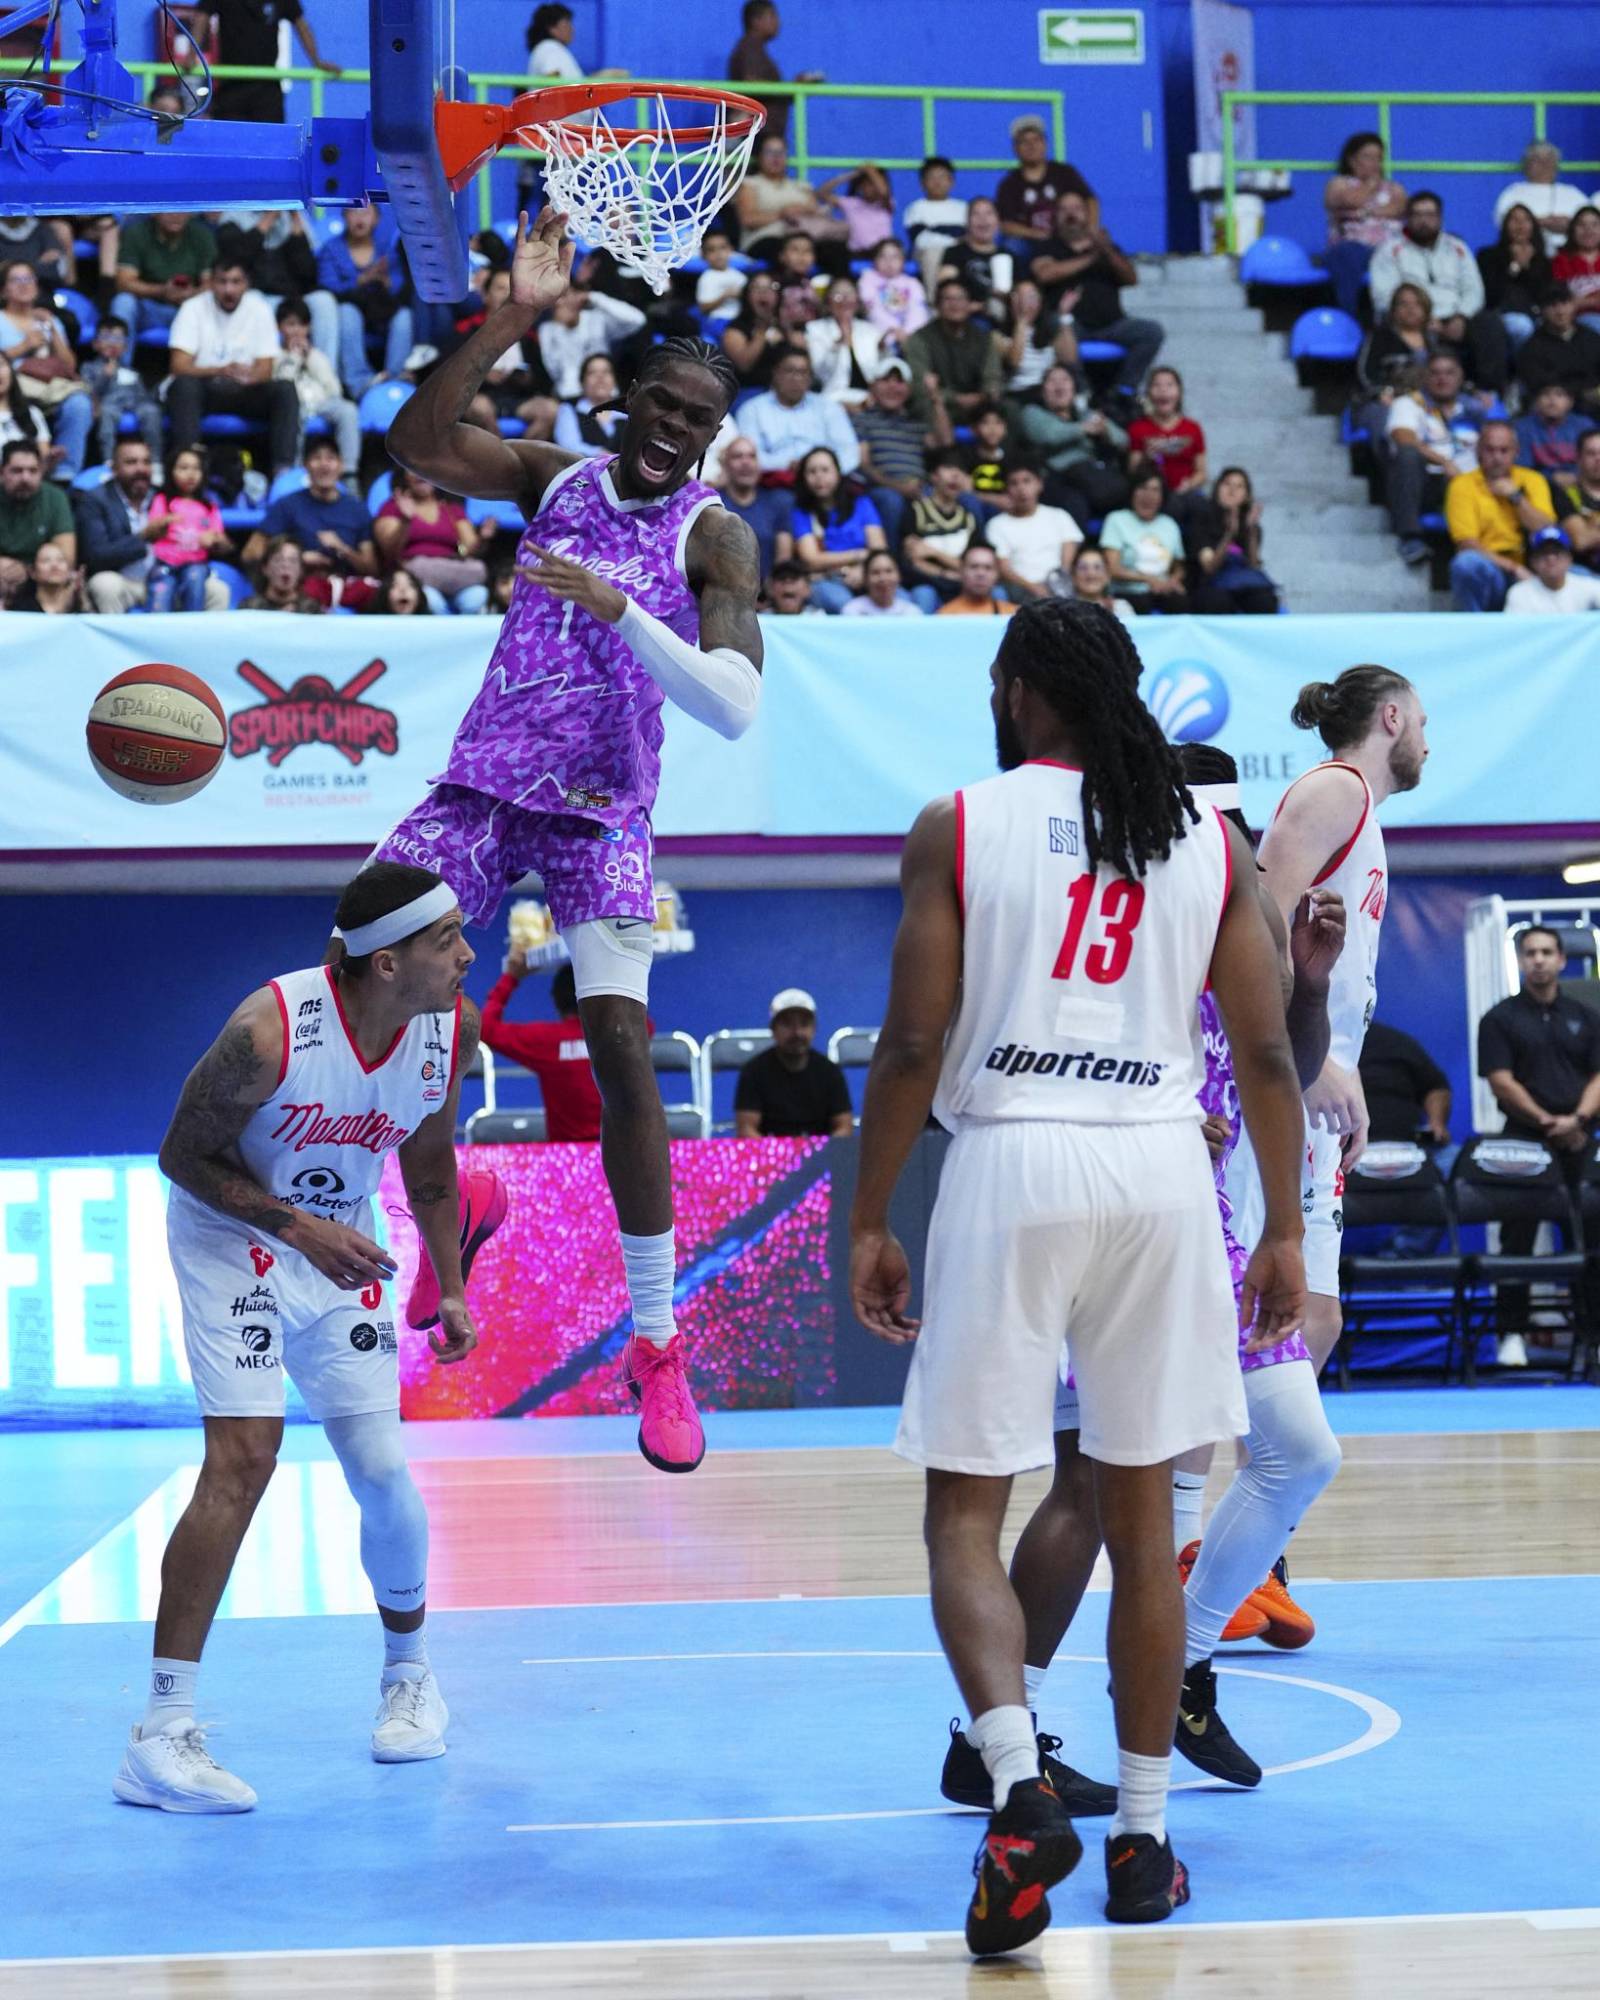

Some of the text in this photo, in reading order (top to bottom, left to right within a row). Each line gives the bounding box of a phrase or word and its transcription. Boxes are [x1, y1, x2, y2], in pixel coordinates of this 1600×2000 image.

[560, 600, 576, 642] 1
[110, 697, 205, 736] SPALDING
[111, 737, 192, 766] LEGACY
[1241, 753, 1296, 780] BLE
[263, 774, 367, 789] GAMES BAR
[386, 833, 442, 874] MEGA
[613, 879, 643, 900] plus
[1051, 873, 1146, 985] 13
[985, 1044, 1164, 1087] dportenis
